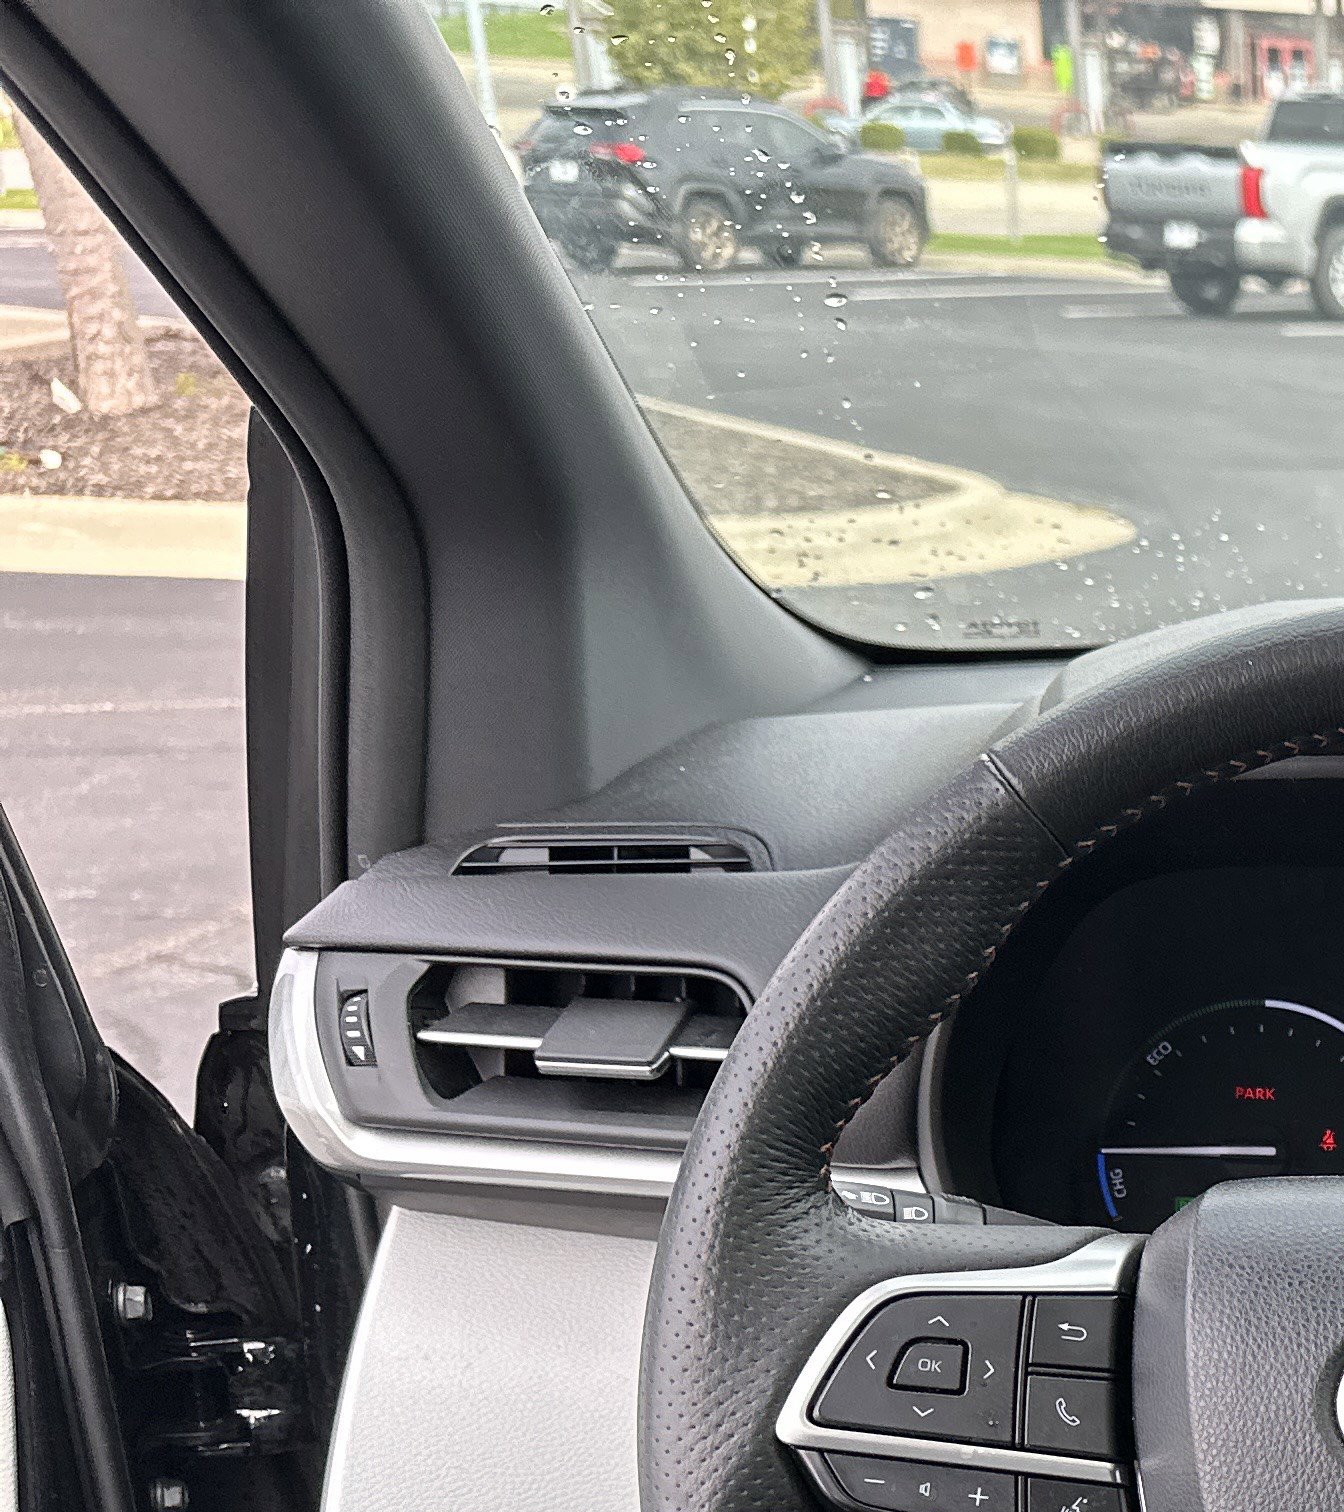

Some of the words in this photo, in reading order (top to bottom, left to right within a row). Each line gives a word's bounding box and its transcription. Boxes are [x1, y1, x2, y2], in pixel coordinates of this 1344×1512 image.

[1146, 1041, 1173, 1066] ECO
[1234, 1086, 1277, 1101] PARK
[1109, 1168, 1127, 1199] CHG
[918, 1358, 942, 1373] OK
